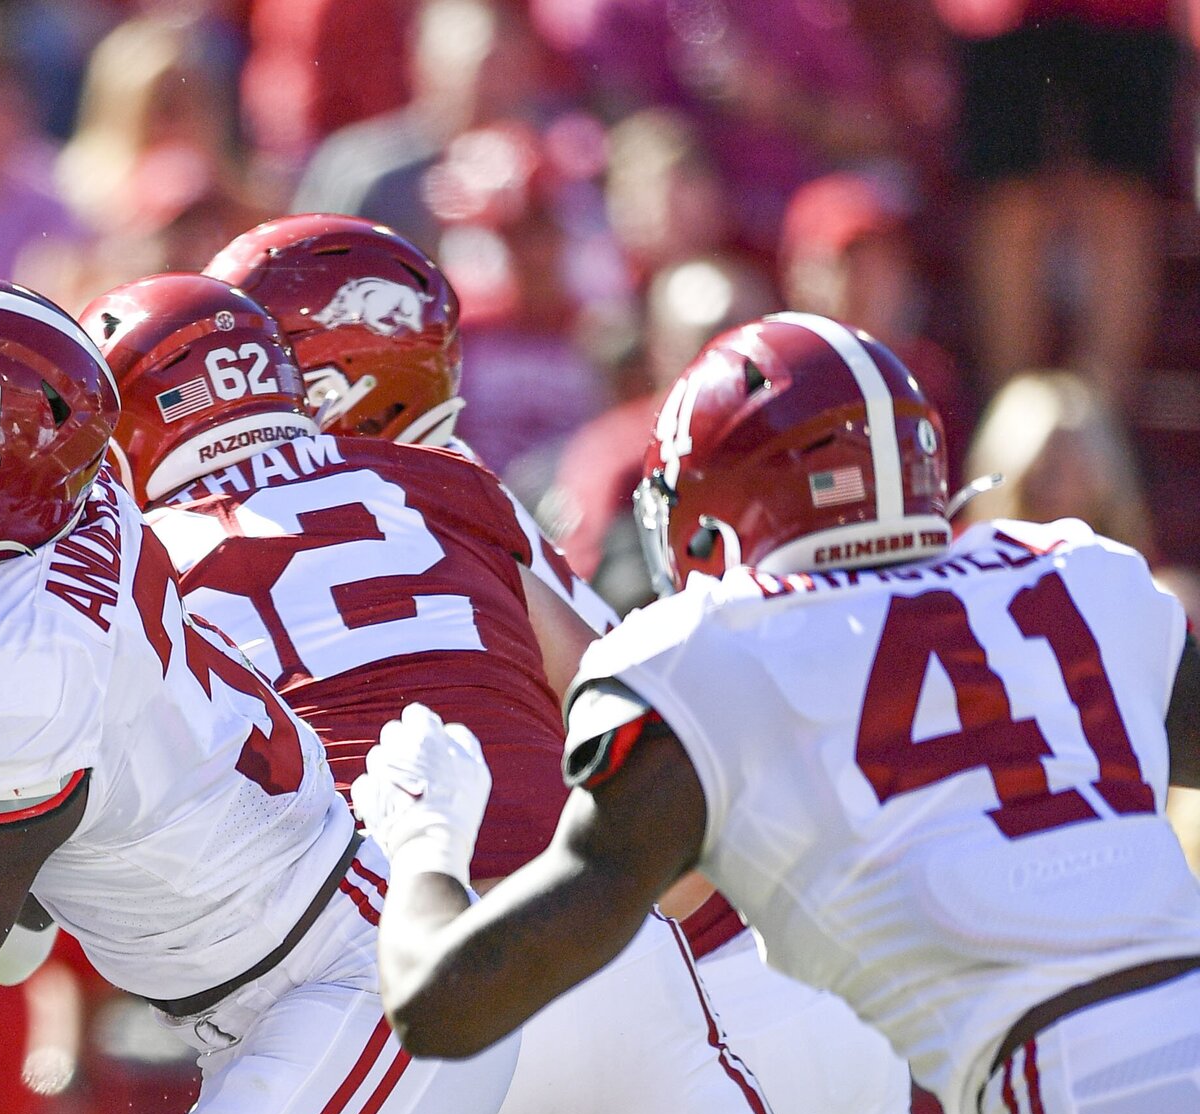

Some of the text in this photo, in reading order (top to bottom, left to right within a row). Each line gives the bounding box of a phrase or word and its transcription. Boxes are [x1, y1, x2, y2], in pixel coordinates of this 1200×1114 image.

[204, 342, 279, 401] 62
[814, 533, 914, 565] CRIMSON
[855, 571, 1157, 842] 41
